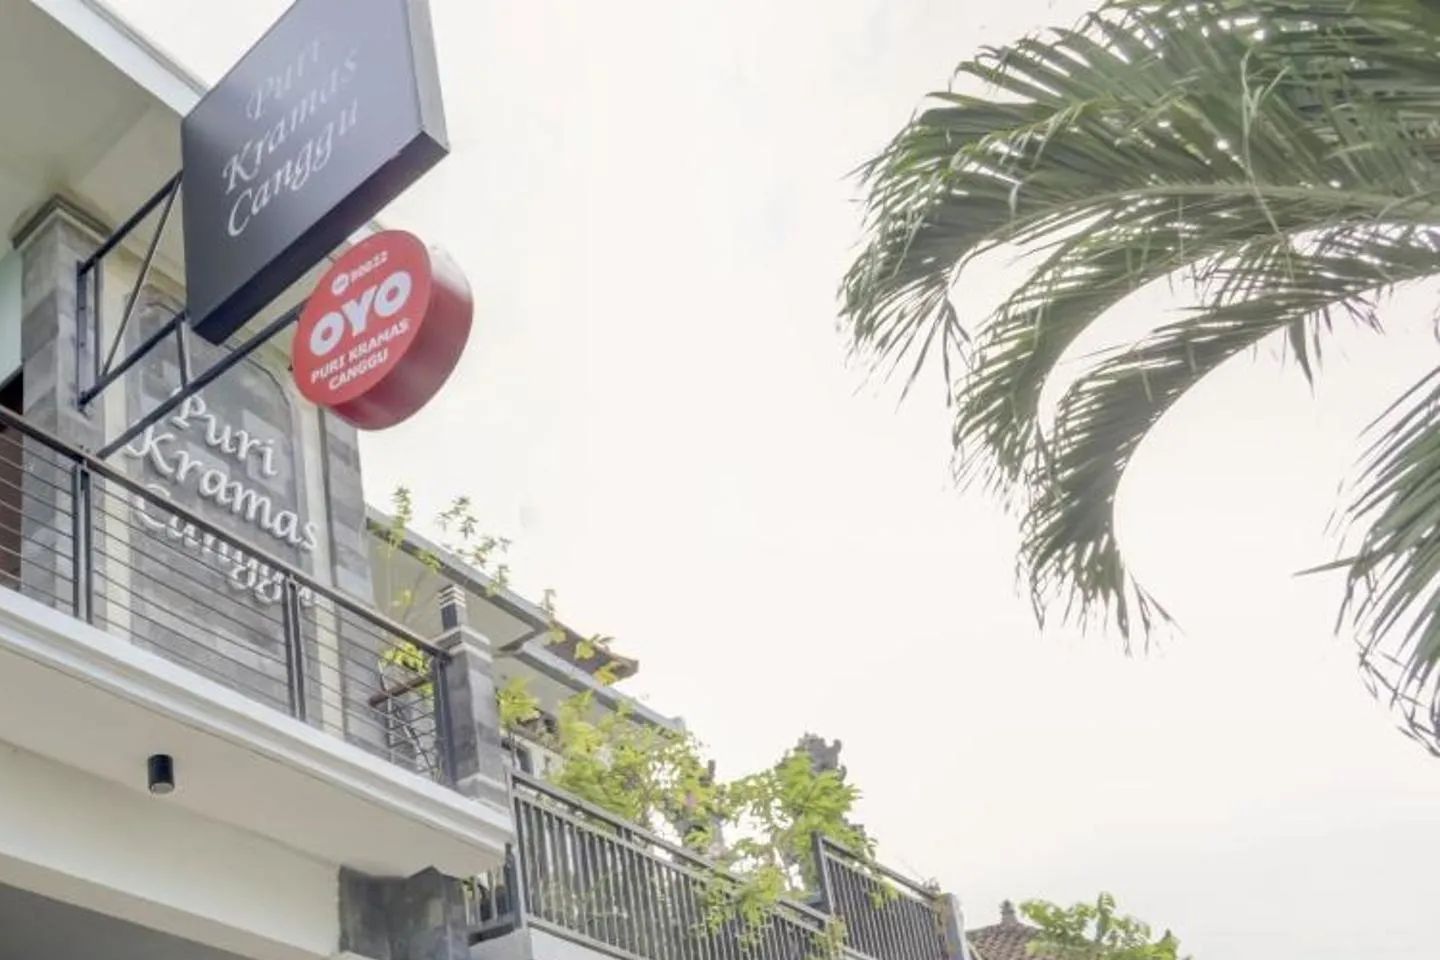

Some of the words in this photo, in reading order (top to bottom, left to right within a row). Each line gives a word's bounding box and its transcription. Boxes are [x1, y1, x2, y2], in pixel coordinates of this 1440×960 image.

[222, 48, 359, 195] Kramas
[245, 35, 320, 121] Puri
[227, 97, 358, 237] Canggu
[310, 271, 412, 357] OYO
[311, 353, 345, 384] PURI
[348, 317, 411, 364] KRAMAS
[328, 347, 389, 391] CANGGU
[170, 387, 279, 477] Puri
[125, 420, 319, 551] Kramas
